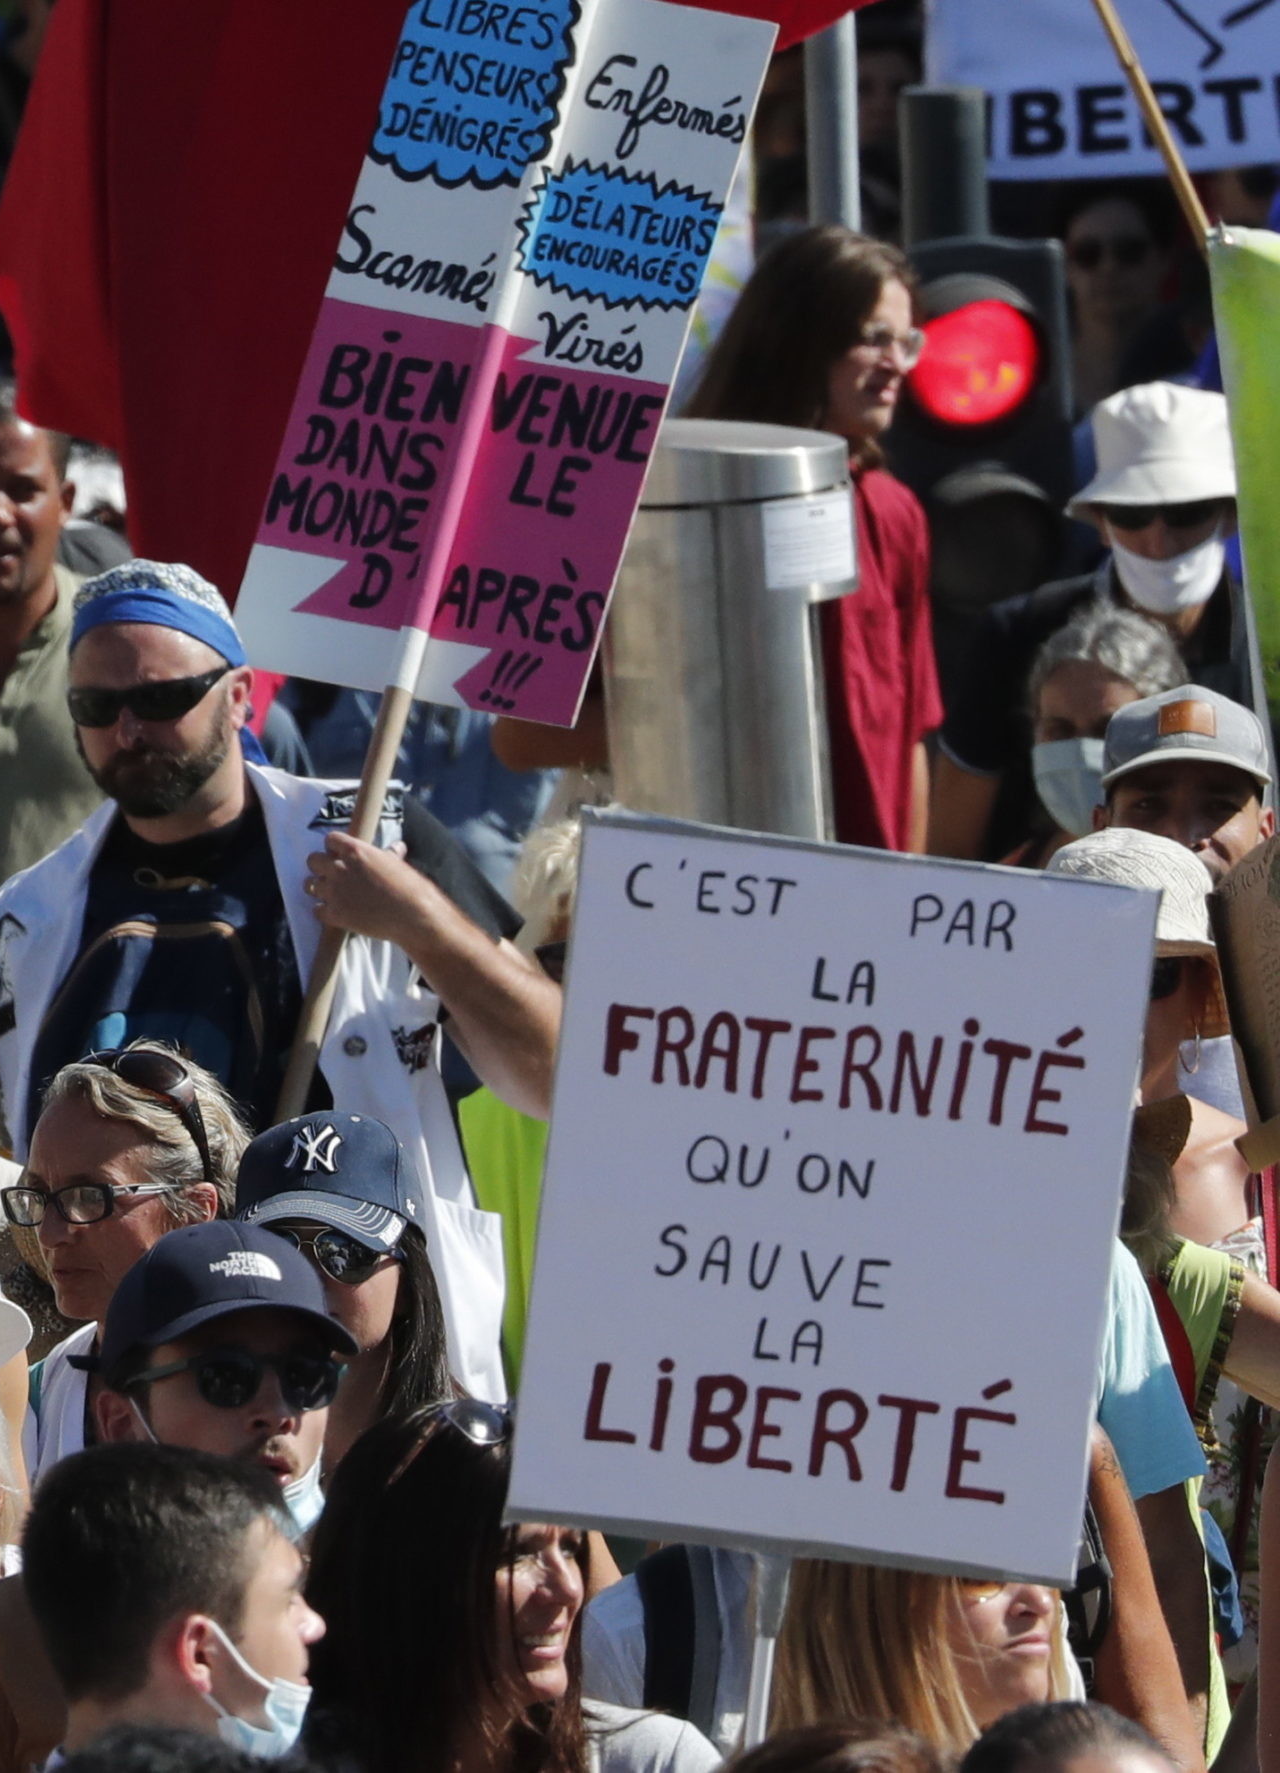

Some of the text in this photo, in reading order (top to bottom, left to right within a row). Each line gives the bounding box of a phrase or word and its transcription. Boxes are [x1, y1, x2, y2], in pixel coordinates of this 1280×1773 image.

[420, 0, 558, 50] LIBRES
[391, 40, 557, 114] PENSEURS
[584, 54, 746, 160] Enfermés
[544, 185, 718, 258] DÉLATEURS
[533, 233, 700, 296] ENCOURAGÉS
[537, 312, 644, 374] Virés
[294, 414, 592, 518] DANS LE
[264, 472, 430, 553] MONDE
[625, 858, 1018, 952] C'EST PAR
[811, 957, 877, 1006] LA
[284, 1122, 344, 1173] NY
[686, 1129, 876, 1200] QU'ON
[208, 1259, 257, 1273] NORTH
[224, 1266, 259, 1277] FACE
[227, 1251, 255, 1261] THE
[654, 1223, 892, 1310] SAUVE
[752, 1316, 825, 1366] LA
